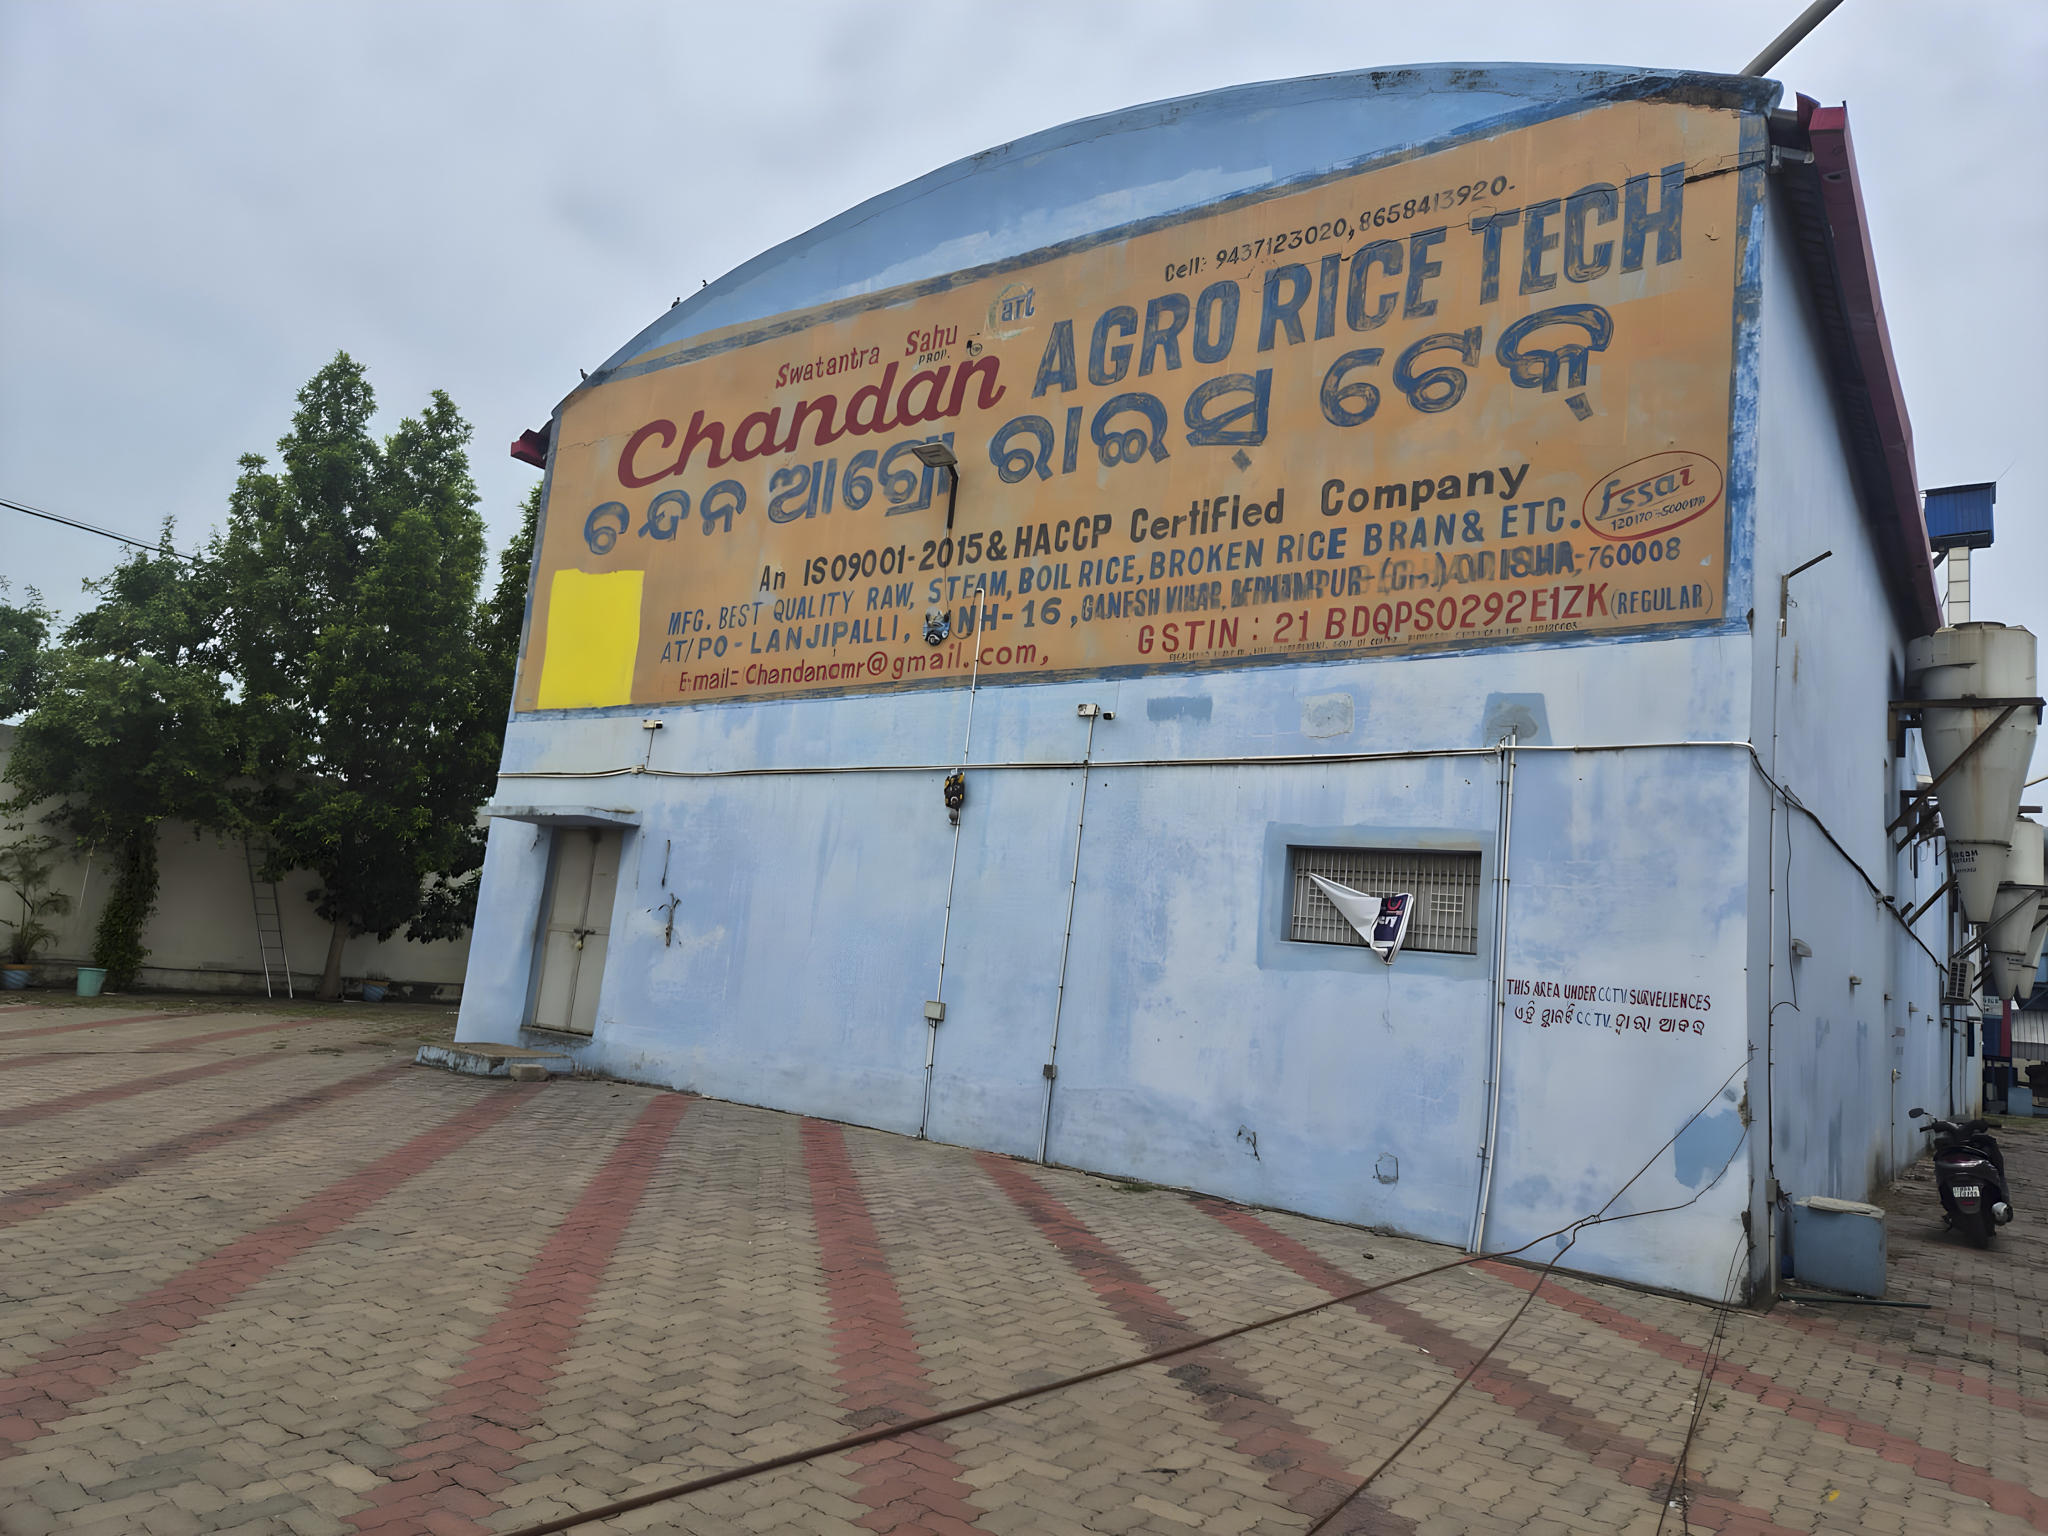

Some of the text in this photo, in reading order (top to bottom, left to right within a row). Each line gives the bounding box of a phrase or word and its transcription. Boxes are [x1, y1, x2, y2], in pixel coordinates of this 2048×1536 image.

[1030, 161, 1687, 399] AGRO RICE TECH
[617, 354, 1007, 488] Chandan
[775, 324, 958, 389] Swatantra Sahu
[718, 601, 765, 631] BEST
[773, 589, 856, 623] QUALITY
[866, 580, 916, 612] RAW,
[1276, 526, 1348, 565] RICE
[1500, 496, 1582, 539] ETC.
[759, 564, 787, 592] An
[1320, 463, 1531, 517] Company
[1137, 616, 1240, 655] GSTIN
[1610, 578, 1714, 620] (REGULAR)
[1506, 978, 1531, 996] THIS
[1532, 981, 1561, 999] AREA
[1564, 984, 1597, 1002] UNDER
